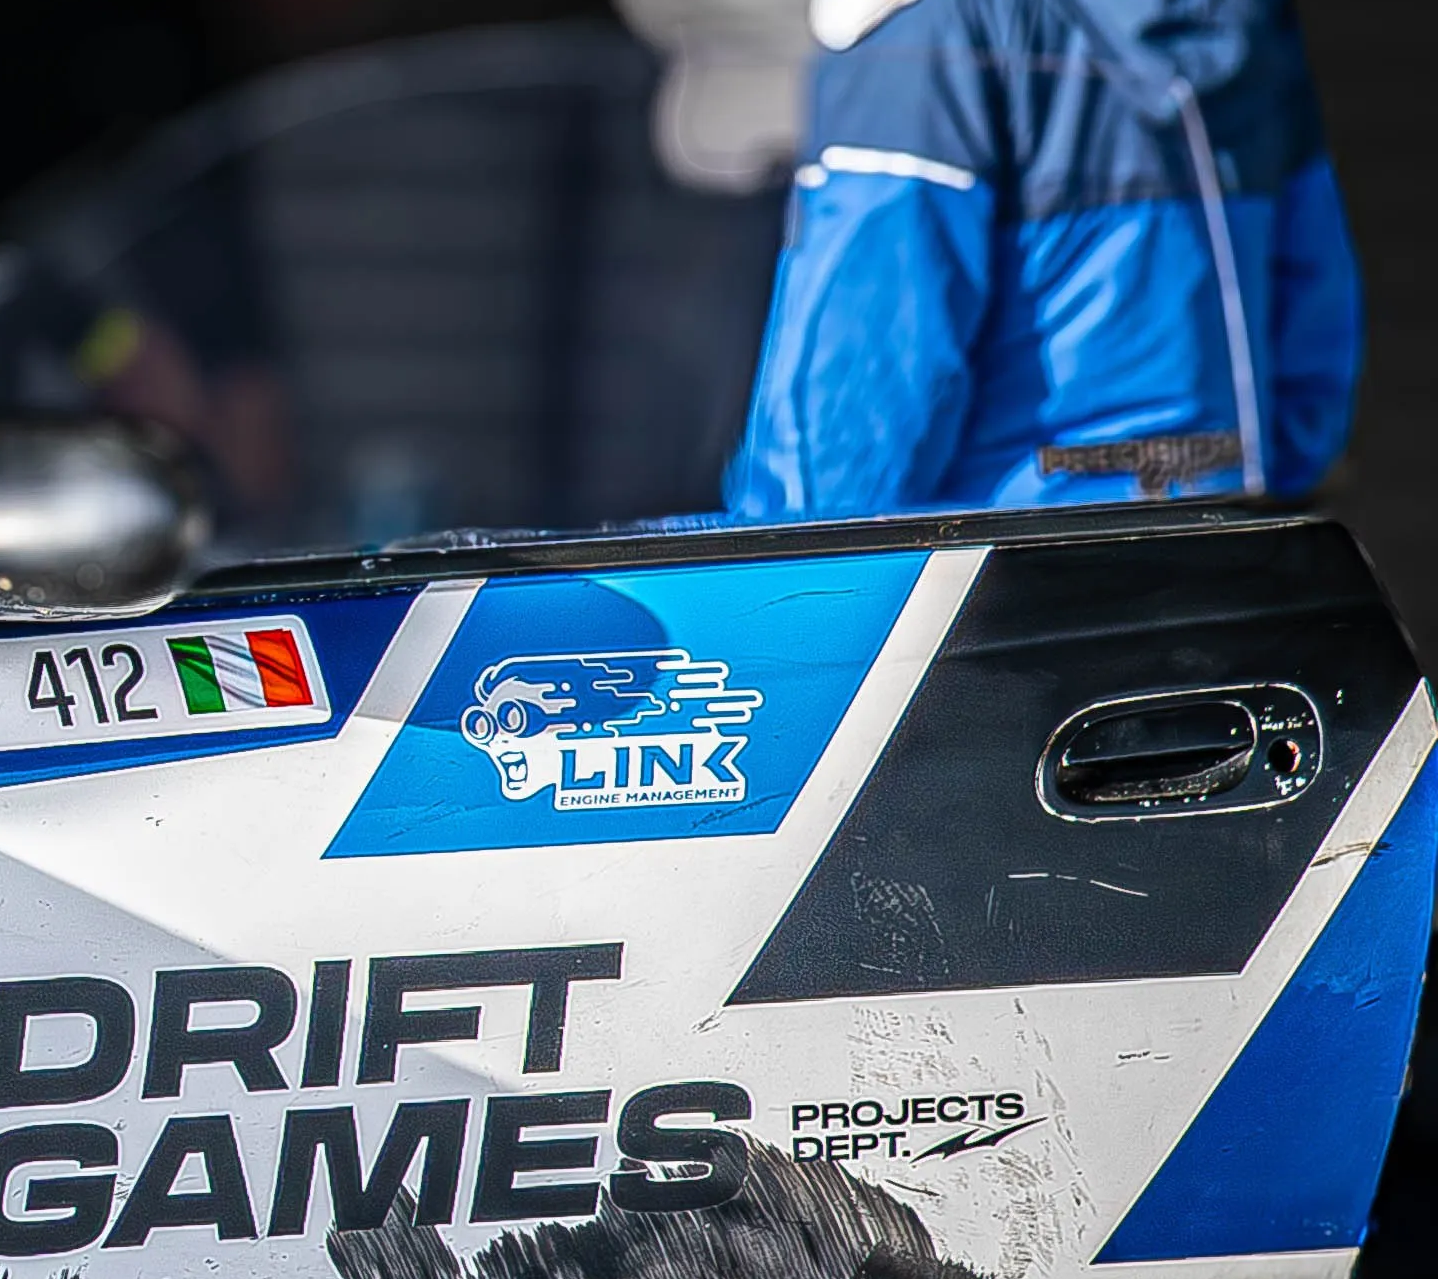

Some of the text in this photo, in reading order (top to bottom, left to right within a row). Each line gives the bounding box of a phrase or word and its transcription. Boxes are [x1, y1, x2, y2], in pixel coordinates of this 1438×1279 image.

[25, 643, 158, 728] 412
[560, 740, 739, 790] LINK
[560, 788, 741, 806] ENGINE MANAGEMENT
[790, 1092, 1026, 1132] PROJECTS
[791, 1131, 912, 1164] DEPT.
